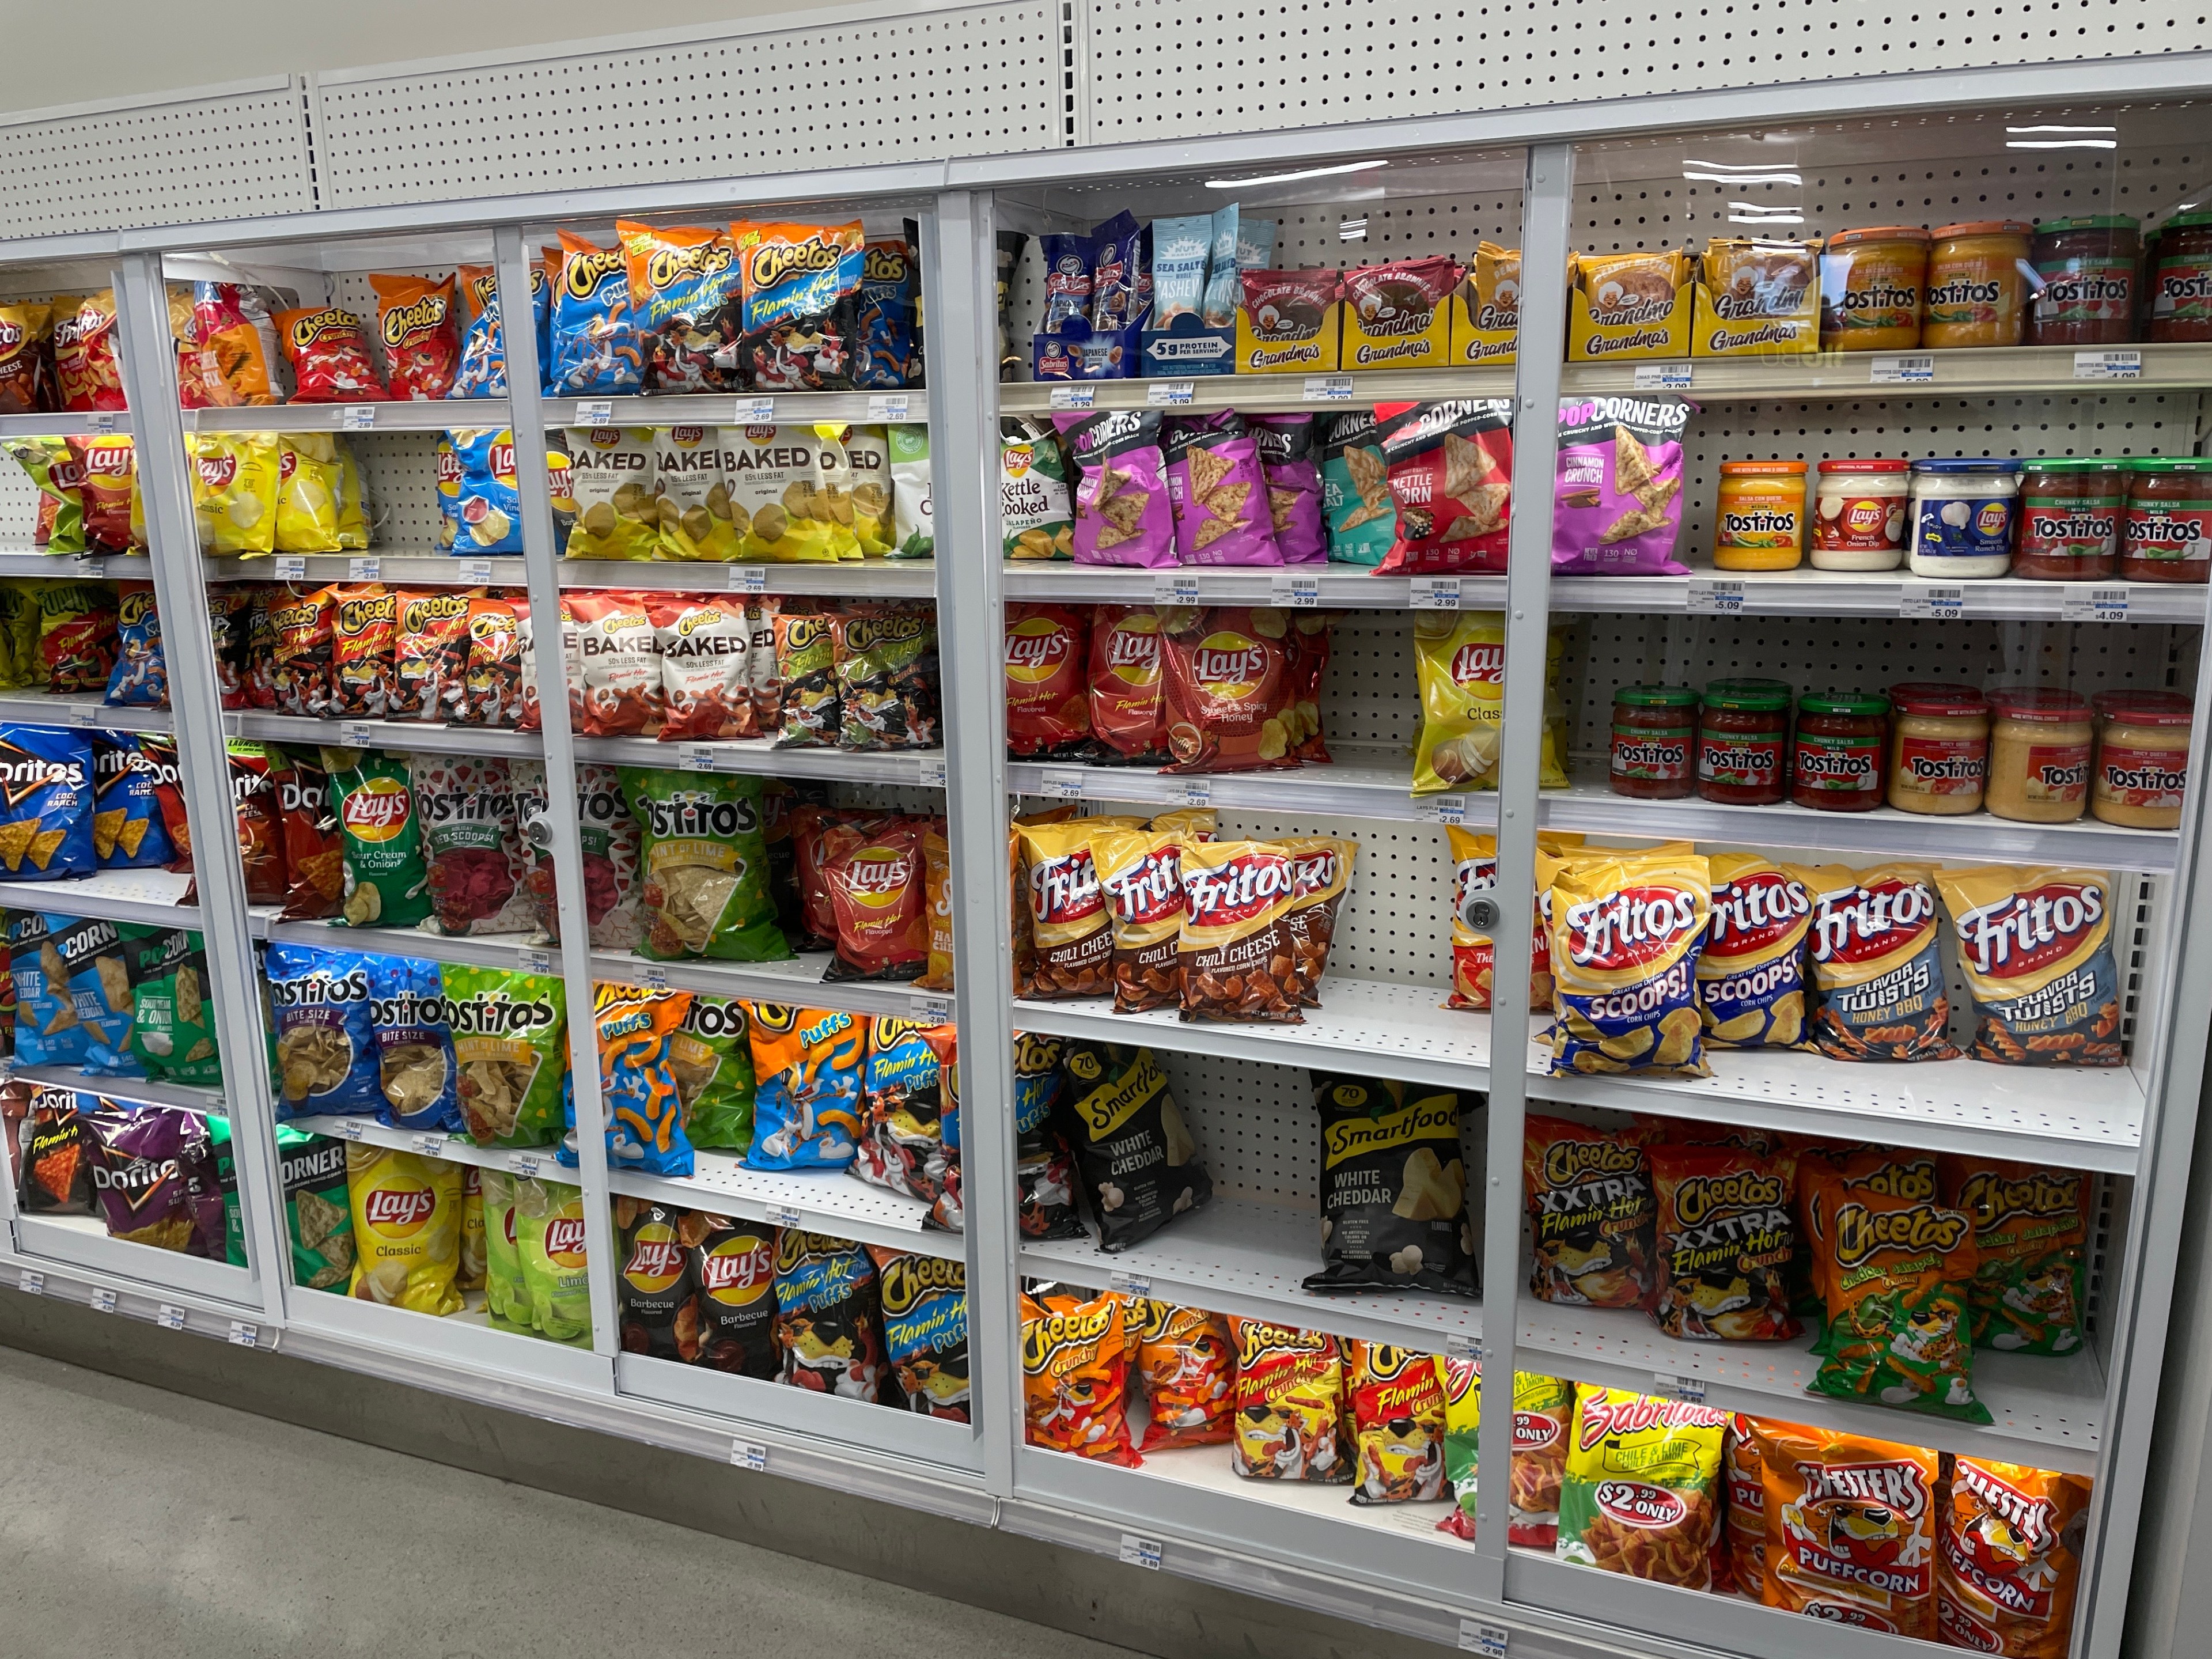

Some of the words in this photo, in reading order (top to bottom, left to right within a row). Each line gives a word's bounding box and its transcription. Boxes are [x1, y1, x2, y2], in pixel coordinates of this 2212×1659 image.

[649, 244, 732, 289] Cheetos
[752, 238, 842, 289] Cheetos
[1157, 263, 1175, 272] SEA
[1252, 286, 1291, 309] CHOCOLATE
[1351, 274, 1392, 301] CHOCOLATE
[1395, 273, 1430, 291] BROWNIE
[384, 297, 447, 346] Cheetos
[1586, 329, 1668, 355] Grandma's
[1710, 324, 1796, 351] Grandma's
[1250, 344, 1319, 368] Grandma's
[1357, 339, 1430, 365] Grandma's
[724, 448, 810, 472] BAKED
[1005, 450, 1033, 469] Lay's
[1566, 457, 1604, 468] CINNAMON
[1393, 474, 1433, 490] KETTLE
[1565, 469, 1603, 484] CRUNCH
[1726, 512, 1793, 532] TOSTITOS
[1850, 508, 1881, 525] Lay's
[1979, 510, 2007, 528] Lay's
[2034, 514, 2113, 539] TOSTITOS
[405, 596, 468, 633] Cheetos
[1715, 601, 1739, 609] $5.09
[1931, 609, 1958, 618] $5.09
[2096, 612, 2123, 620] $4.09
[603, 616, 646, 634] Cheetos
[679, 611, 721, 636] Cheetos
[846, 618, 922, 650] Cheetos
[1200, 647, 1263, 685] Lay's
[1221, 713, 1253, 722] Honey
[1234, 703, 1241, 711] &
[1243, 702, 1267, 713] Spicy
[1618, 742, 1683, 764] TOSTITOS
[1705, 747, 1774, 769] TOSTITOS
[1800, 751, 1871, 775] TOSTITOS
[1912, 756, 1984, 778] TOSTITOS
[1062, 790, 1079, 798] $2.69
[1187, 798, 1206, 807] $2.69
[347, 791, 407, 827] Lay's
[1440, 815, 1460, 824] $2.69
[694, 843, 725, 858] LIME
[850, 859, 911, 890] Lay's
[1182, 858, 1293, 922] Fritos
[1220, 906, 1258, 918] BRAND
[1811, 883, 1934, 961] Fritos
[1566, 892, 1695, 965] Fritos
[1733, 931, 1774, 948] BRAND
[1956, 885, 2103, 972] Fritos
[1051, 948, 1078, 962] CHILI
[1139, 950, 1166, 963] CHILI
[1196, 953, 1225, 967] CHILI
[1229, 930, 1280, 962] CHEESE
[1855, 935, 1898, 955] BRAND
[2018, 946, 2063, 967] BRAND
[1591, 963, 1687, 1019] SCOOPS!
[1838, 967, 1929, 1012] TWISTS
[1855, 963, 1912, 996] FLAVOR
[2017, 972, 2077, 1007] FLAVOR
[1741, 998, 1756, 1006] CORN
[1757, 994, 1773, 1003] CHIPS
[1998, 972, 2096, 1021] TWISTS
[286, 1011, 304, 1022] BITE
[308, 1009, 330, 1020] SIZE
[1627, 1014, 1643, 1023] CORN
[1645, 1010, 1661, 1020] CHIPS
[1853, 1007, 1891, 1023] HONEY
[1896, 997, 1922, 1015] BBQ
[2016, 1017, 2055, 1032] HONEY
[2065, 1002, 2088, 1022] BBQ
[382, 1032, 399, 1042] BITE
[403, 1031, 425, 1040] SIZE
[1341, 1088, 1359, 1099] 70
[1110, 1130, 1152, 1156] WHITE
[1112, 1146, 1164, 1176] CHEDDAR
[1545, 1142, 1642, 1186] Cheetos
[1335, 1170, 1380, 1187] WHITE
[1327, 1187, 1391, 1210] CHEDDAR
[1536, 1175, 1645, 1214] XXTRA
[1677, 1172, 1783, 1225] Cheetos
[369, 1190, 431, 1225] Lay's
[1609, 1198, 1642, 1221] Hot
[1668, 1207, 1791, 1252] XXTRA
[1747, 1230, 1783, 1252] Hot
[1836, 1205, 1968, 1266] Cheetos
[376, 1244, 421, 1257] Classic
[637, 1241, 682, 1277] Lay's
[709, 1247, 771, 1289] Lay's
[824, 1258, 850, 1285] Hot
[1840, 1265, 1887, 1290] Cheddar
[631, 1298, 674, 1309] Barbecue
[721, 1309, 768, 1325] Barbecue
[1516, 1427, 1551, 1441] ONLY
[1616, 1448, 1646, 1461] CHILE
[1651, 1446, 1658, 1455] &
[1662, 1442, 1688, 1453] LIME
[1636, 1502, 1676, 1521] ONLY
[1800, 1548, 1919, 1593] PUFFCORN
[1942, 1533, 2034, 1613] PUFFCORN
